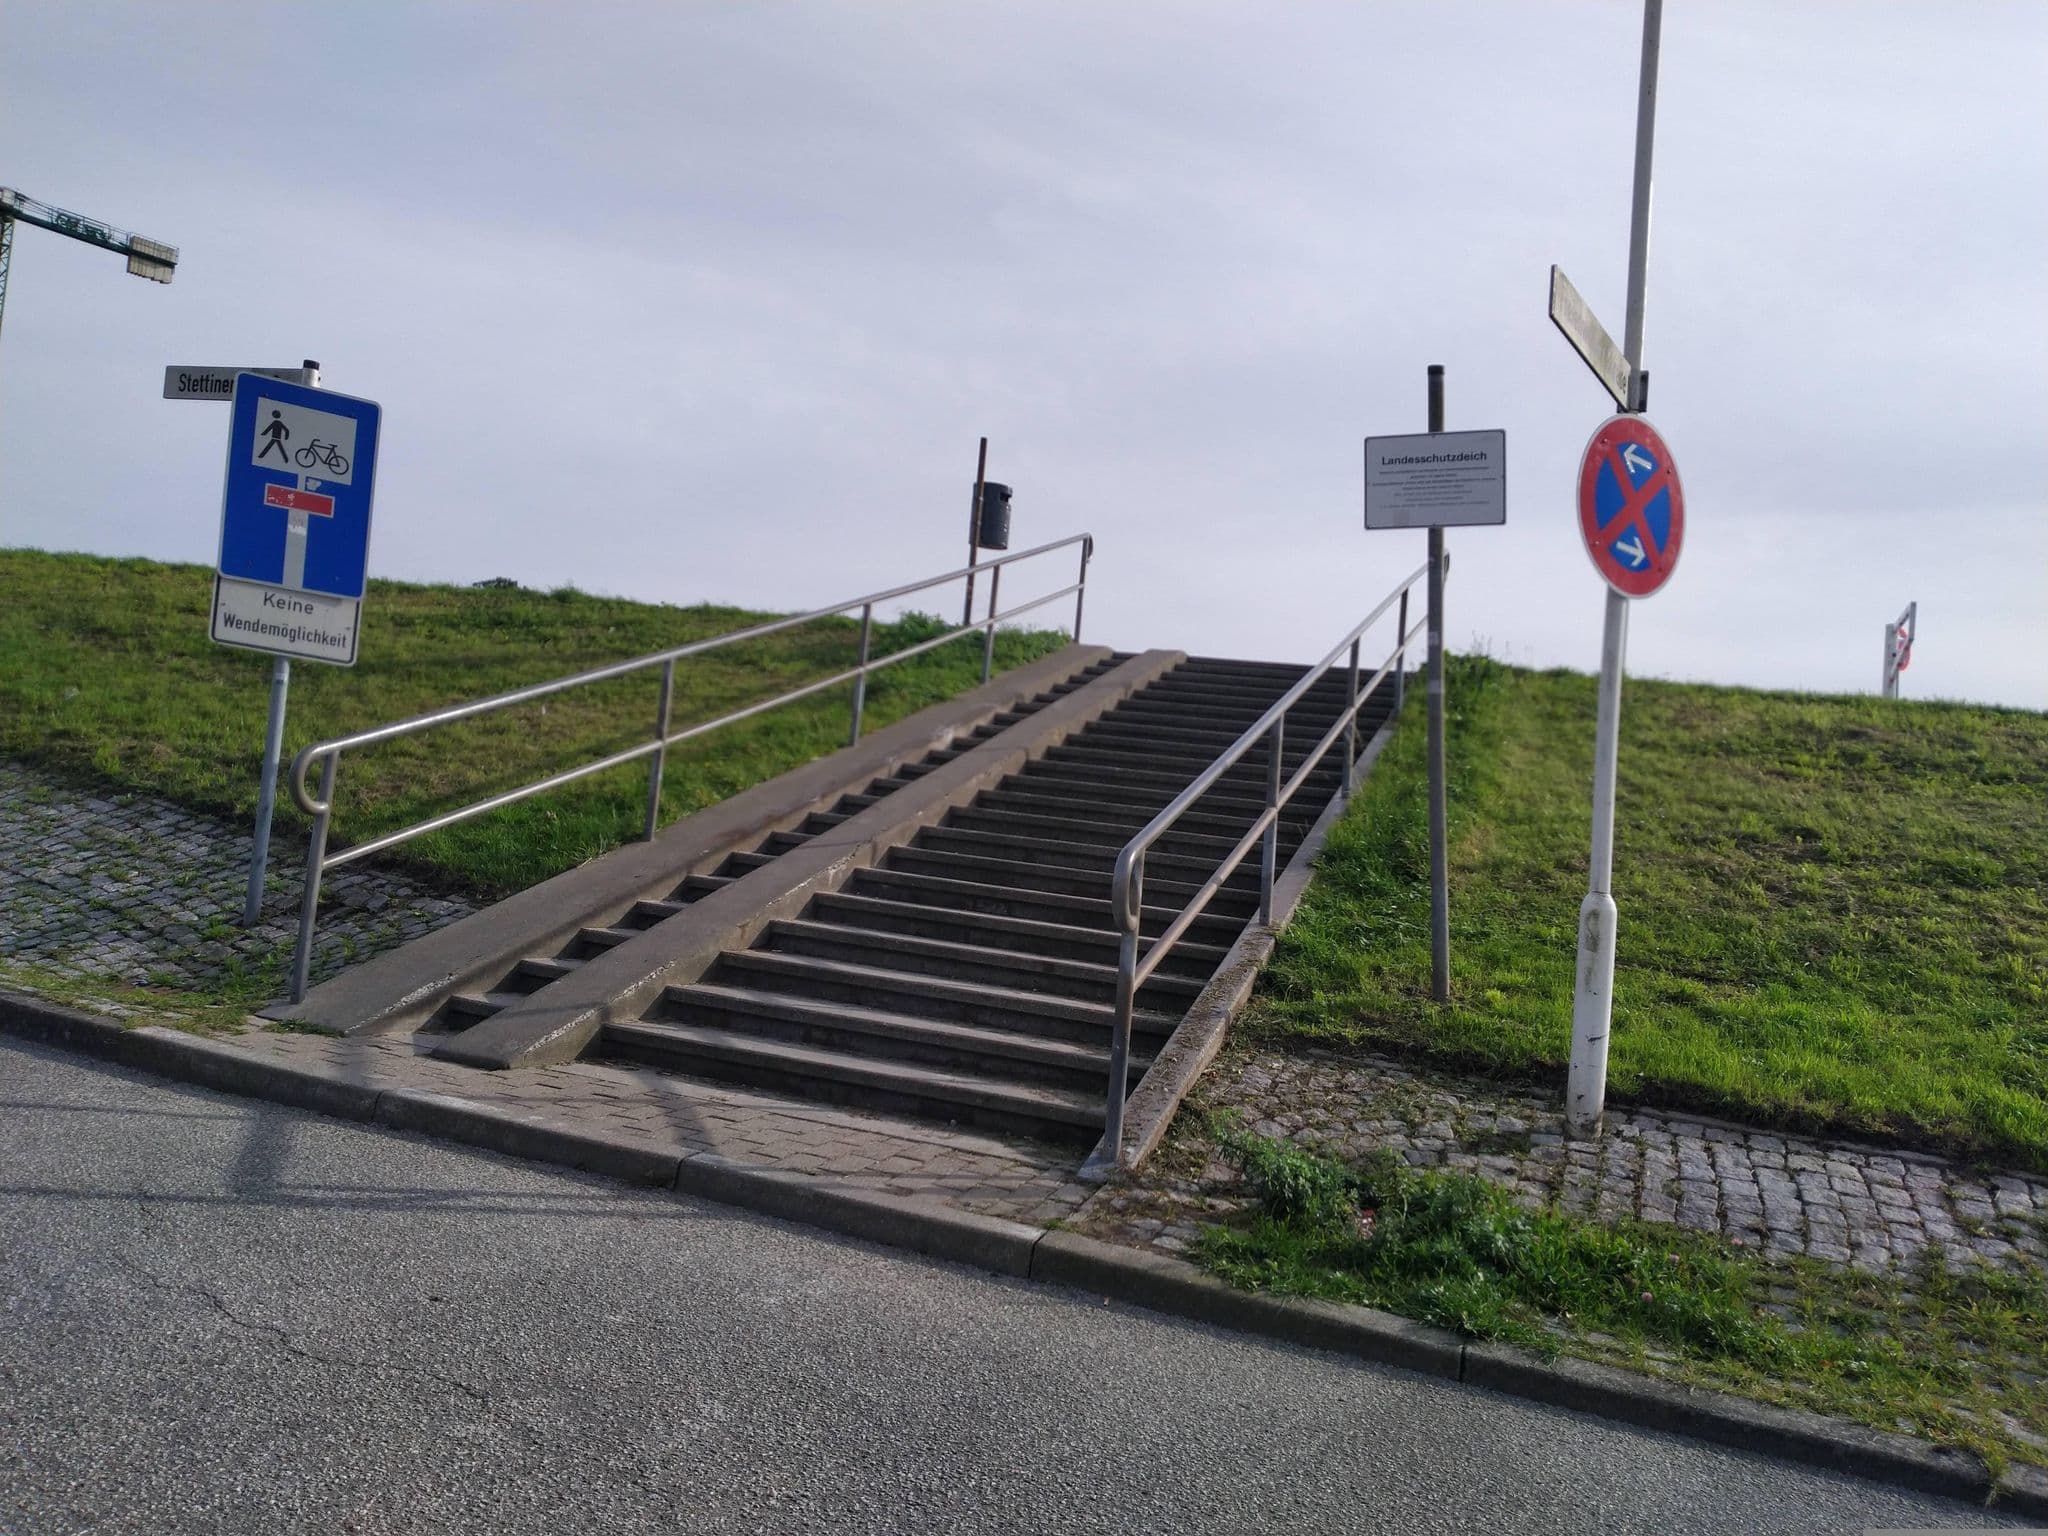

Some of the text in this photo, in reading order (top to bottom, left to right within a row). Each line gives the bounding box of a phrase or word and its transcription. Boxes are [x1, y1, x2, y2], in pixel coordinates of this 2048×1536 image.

[1382, 452, 1487, 465] Landesschutzdeich
[263, 591, 315, 615] Keine
[223, 611, 347, 649] Wendemöglichkeit
